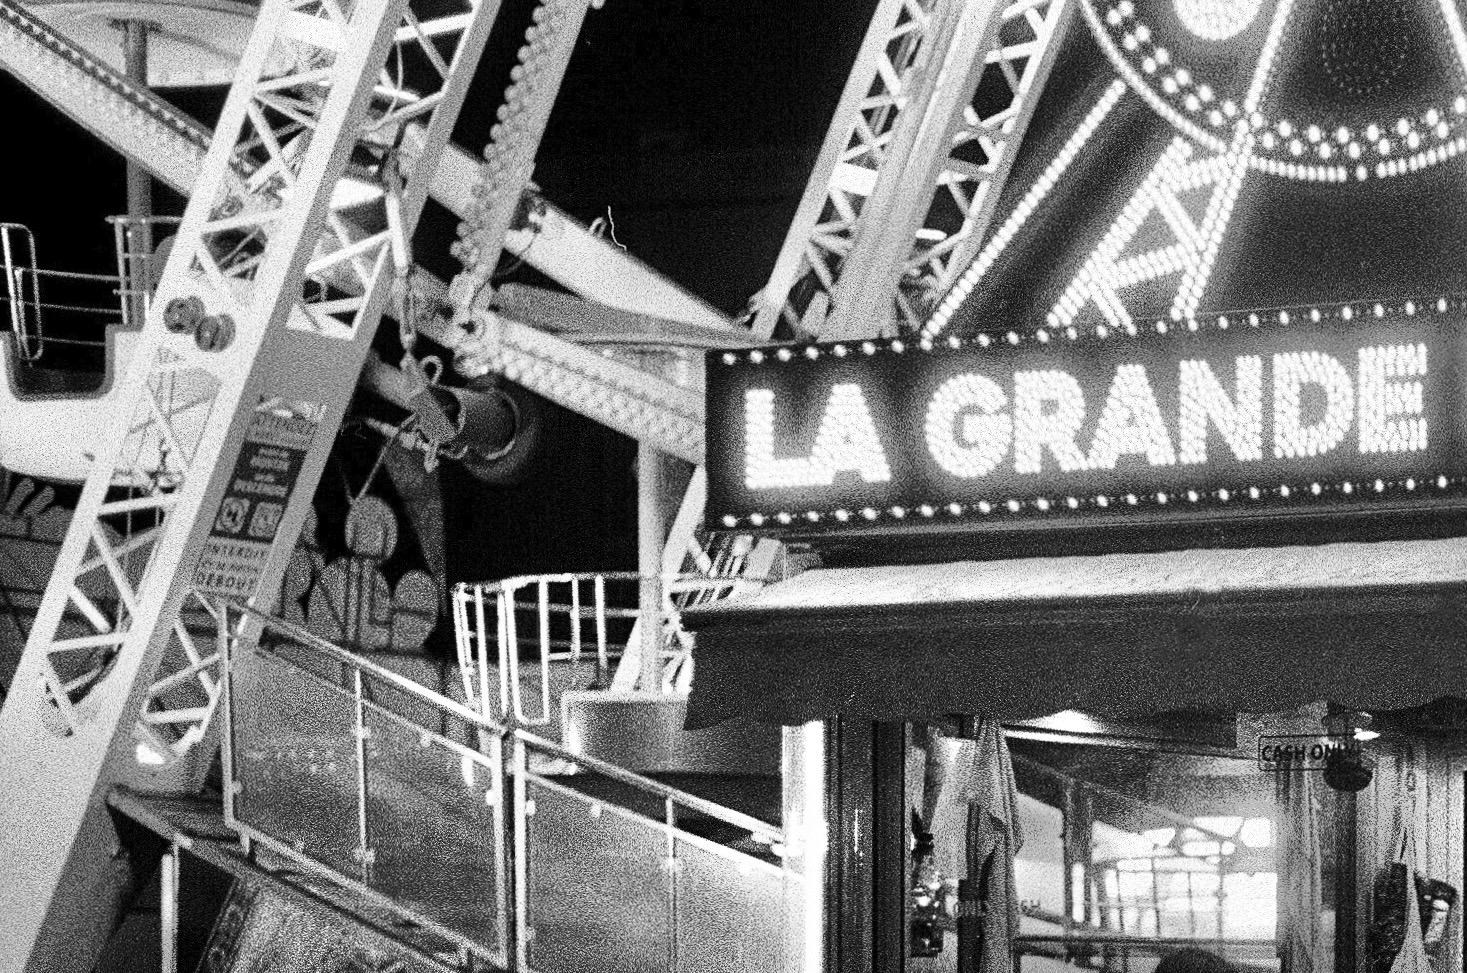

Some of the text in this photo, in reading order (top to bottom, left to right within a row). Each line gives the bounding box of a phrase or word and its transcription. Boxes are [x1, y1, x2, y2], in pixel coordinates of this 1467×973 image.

[742, 381, 892, 490] LA
[923, 341, 1430, 478] GRANDE
[1261, 744, 1305, 761] CASH
